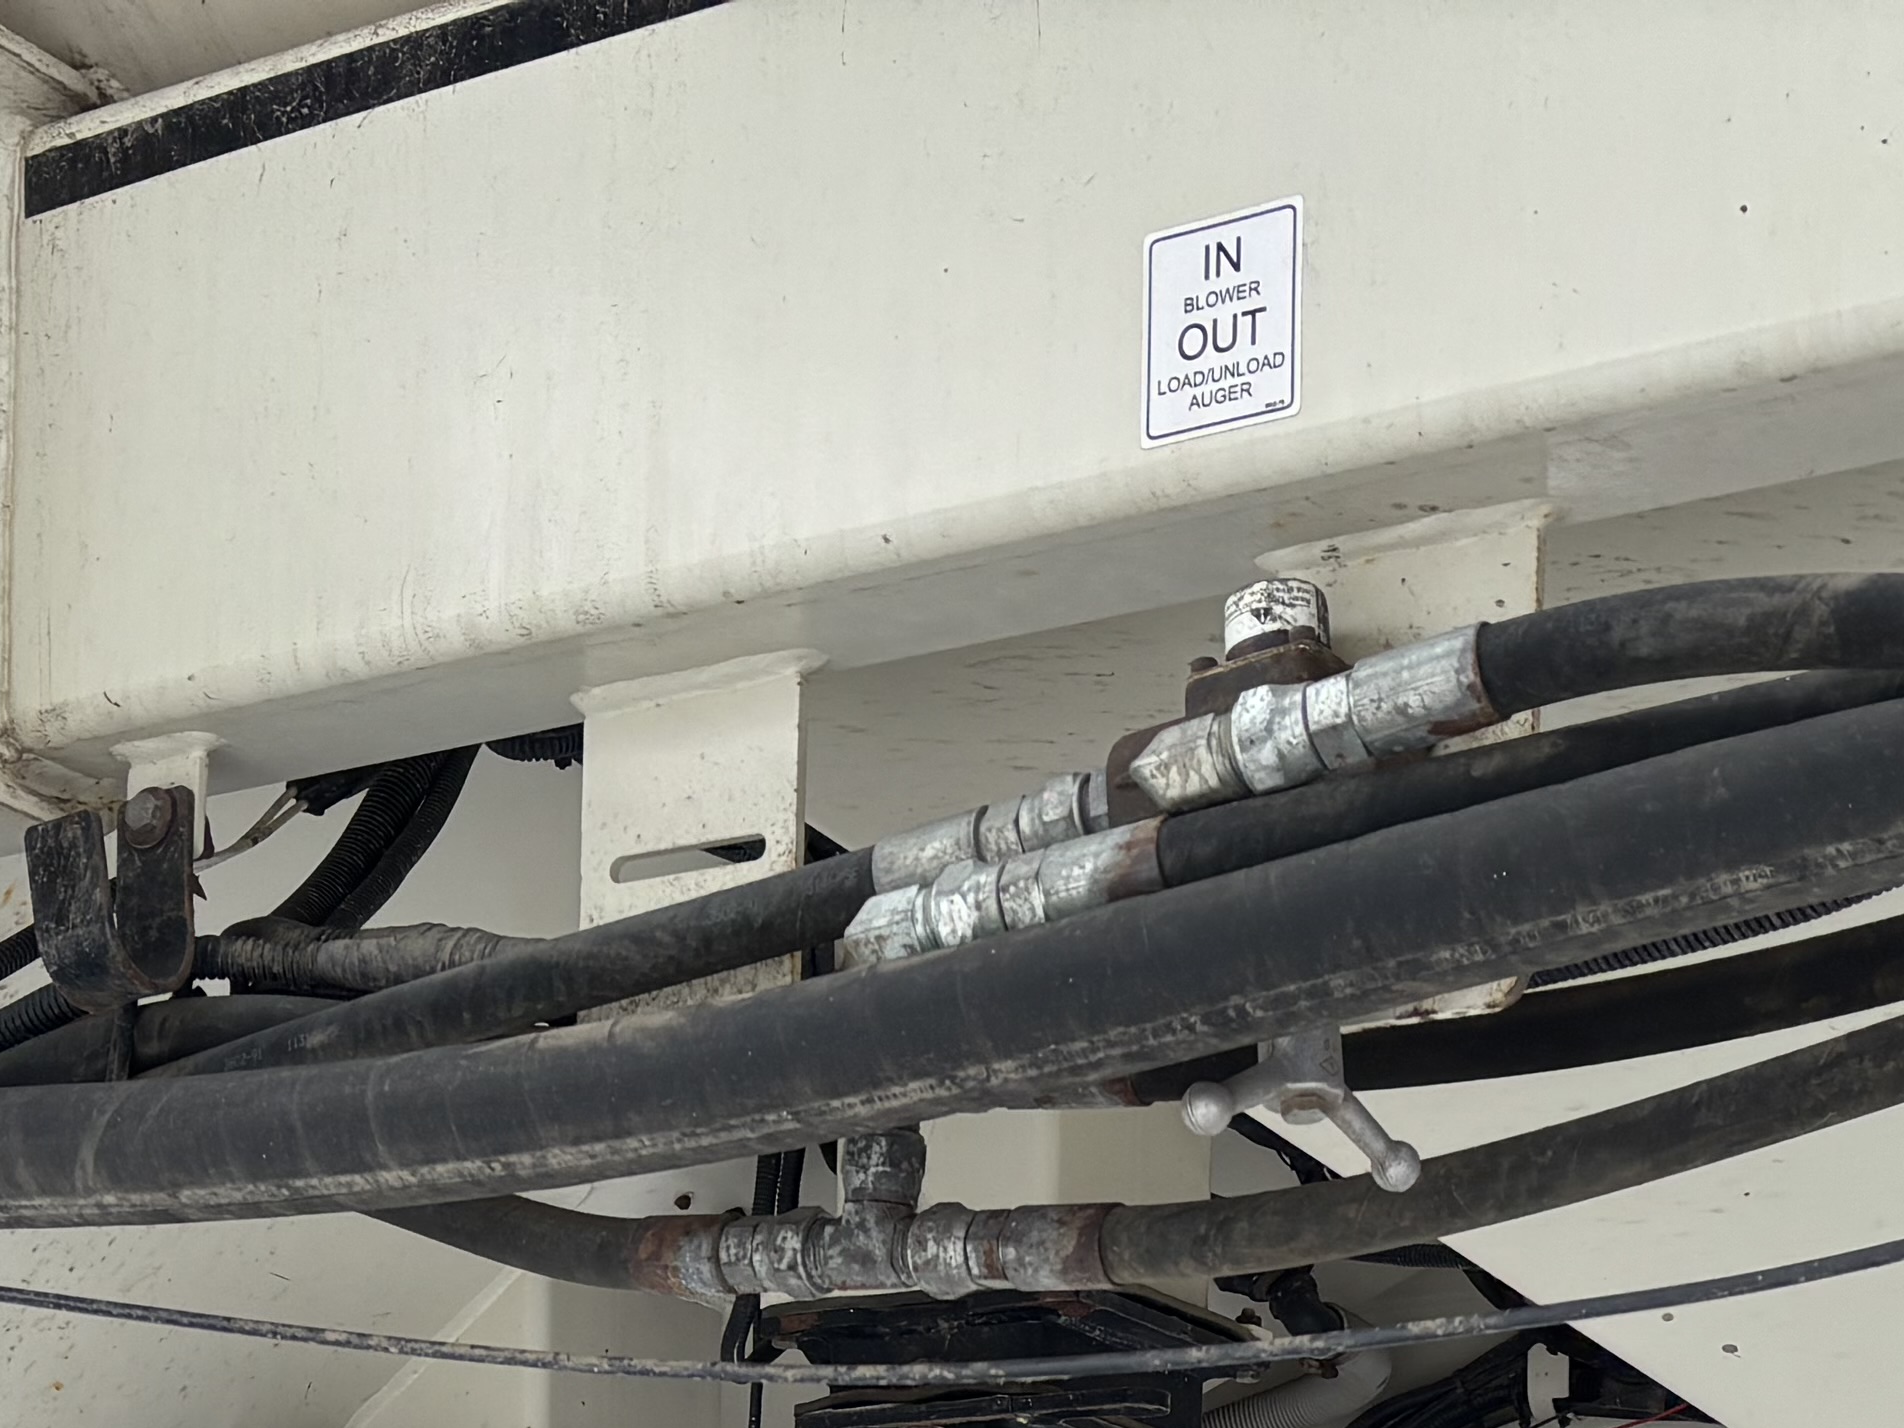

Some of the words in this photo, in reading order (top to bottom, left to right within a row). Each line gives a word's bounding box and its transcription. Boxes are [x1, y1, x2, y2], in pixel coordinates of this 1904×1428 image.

[1204, 236, 1241, 281] IN
[1184, 281, 1260, 314] BLOWER
[1178, 306, 1266, 361] OUT
[1158, 352, 1285, 395] LOAD/UNLOAD
[1188, 382, 1252, 411] AUGER
